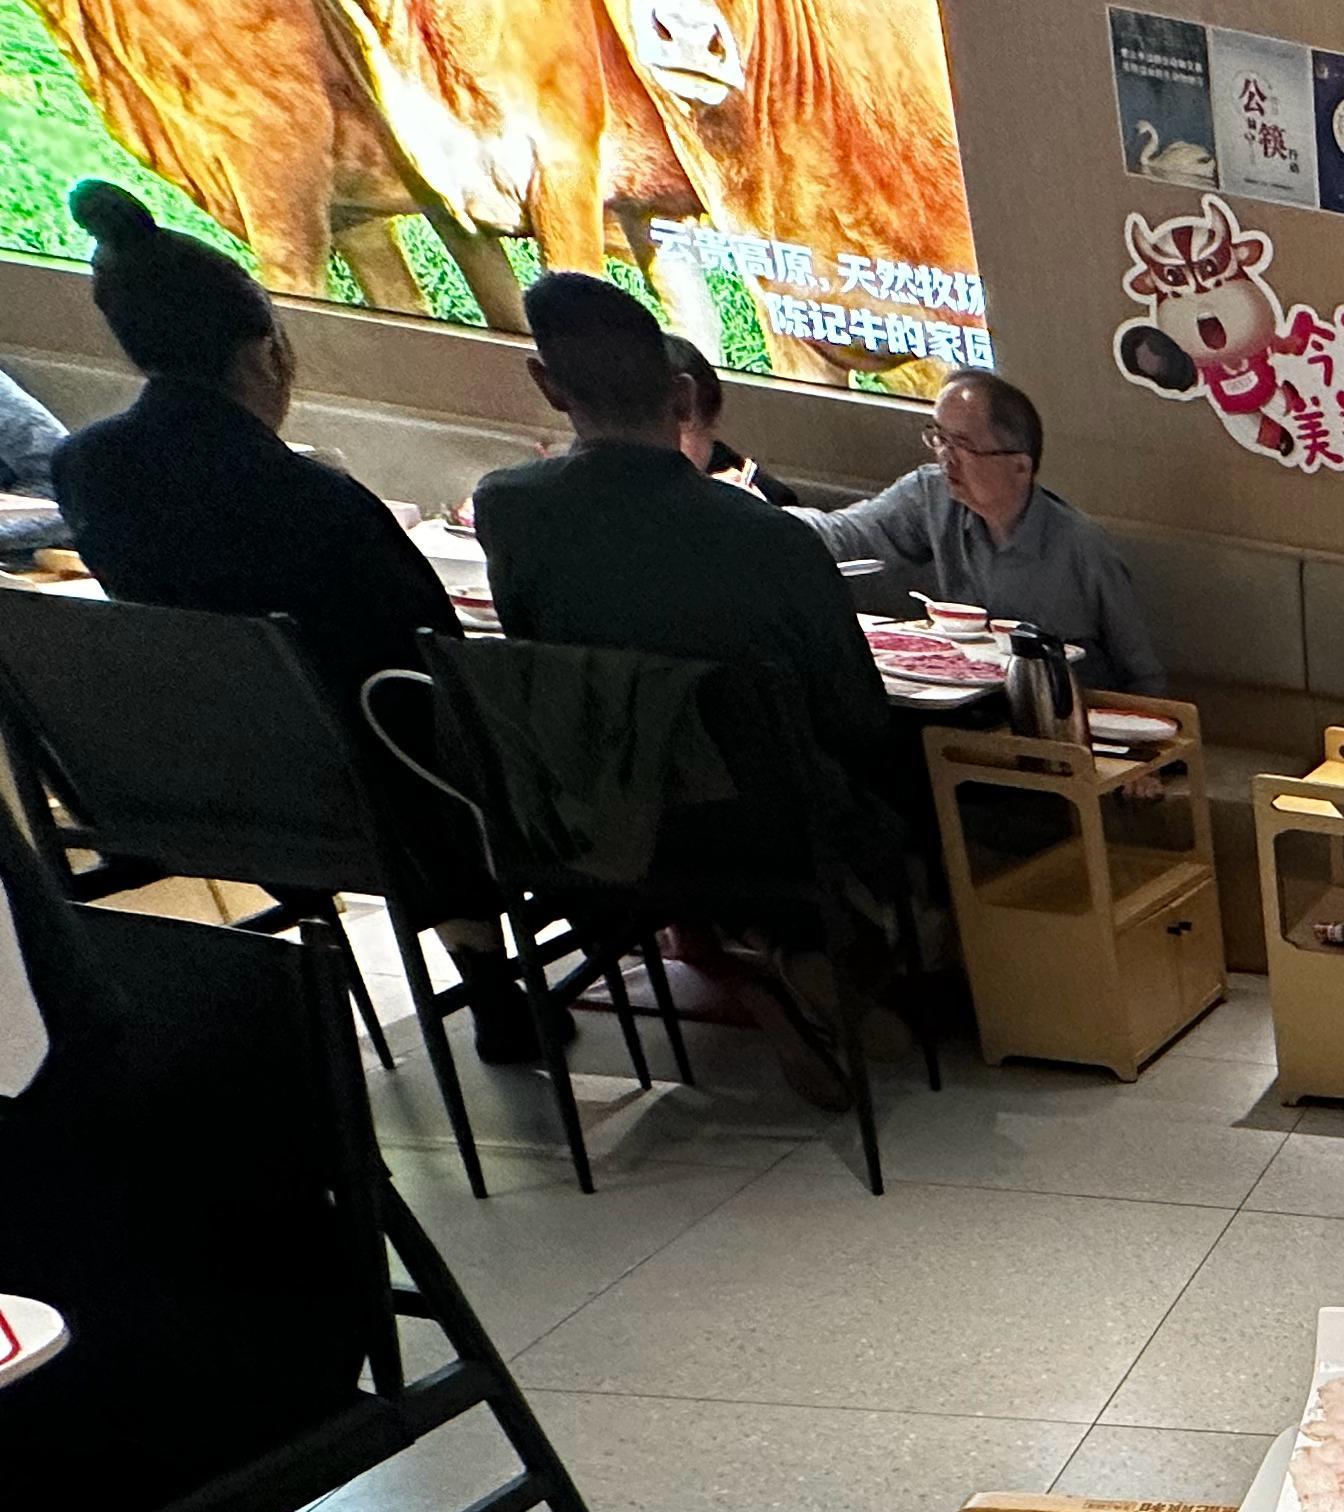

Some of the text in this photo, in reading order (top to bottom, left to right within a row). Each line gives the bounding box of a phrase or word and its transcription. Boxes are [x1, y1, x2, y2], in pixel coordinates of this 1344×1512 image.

[767, 291, 995, 370] 陈记牛的家园
